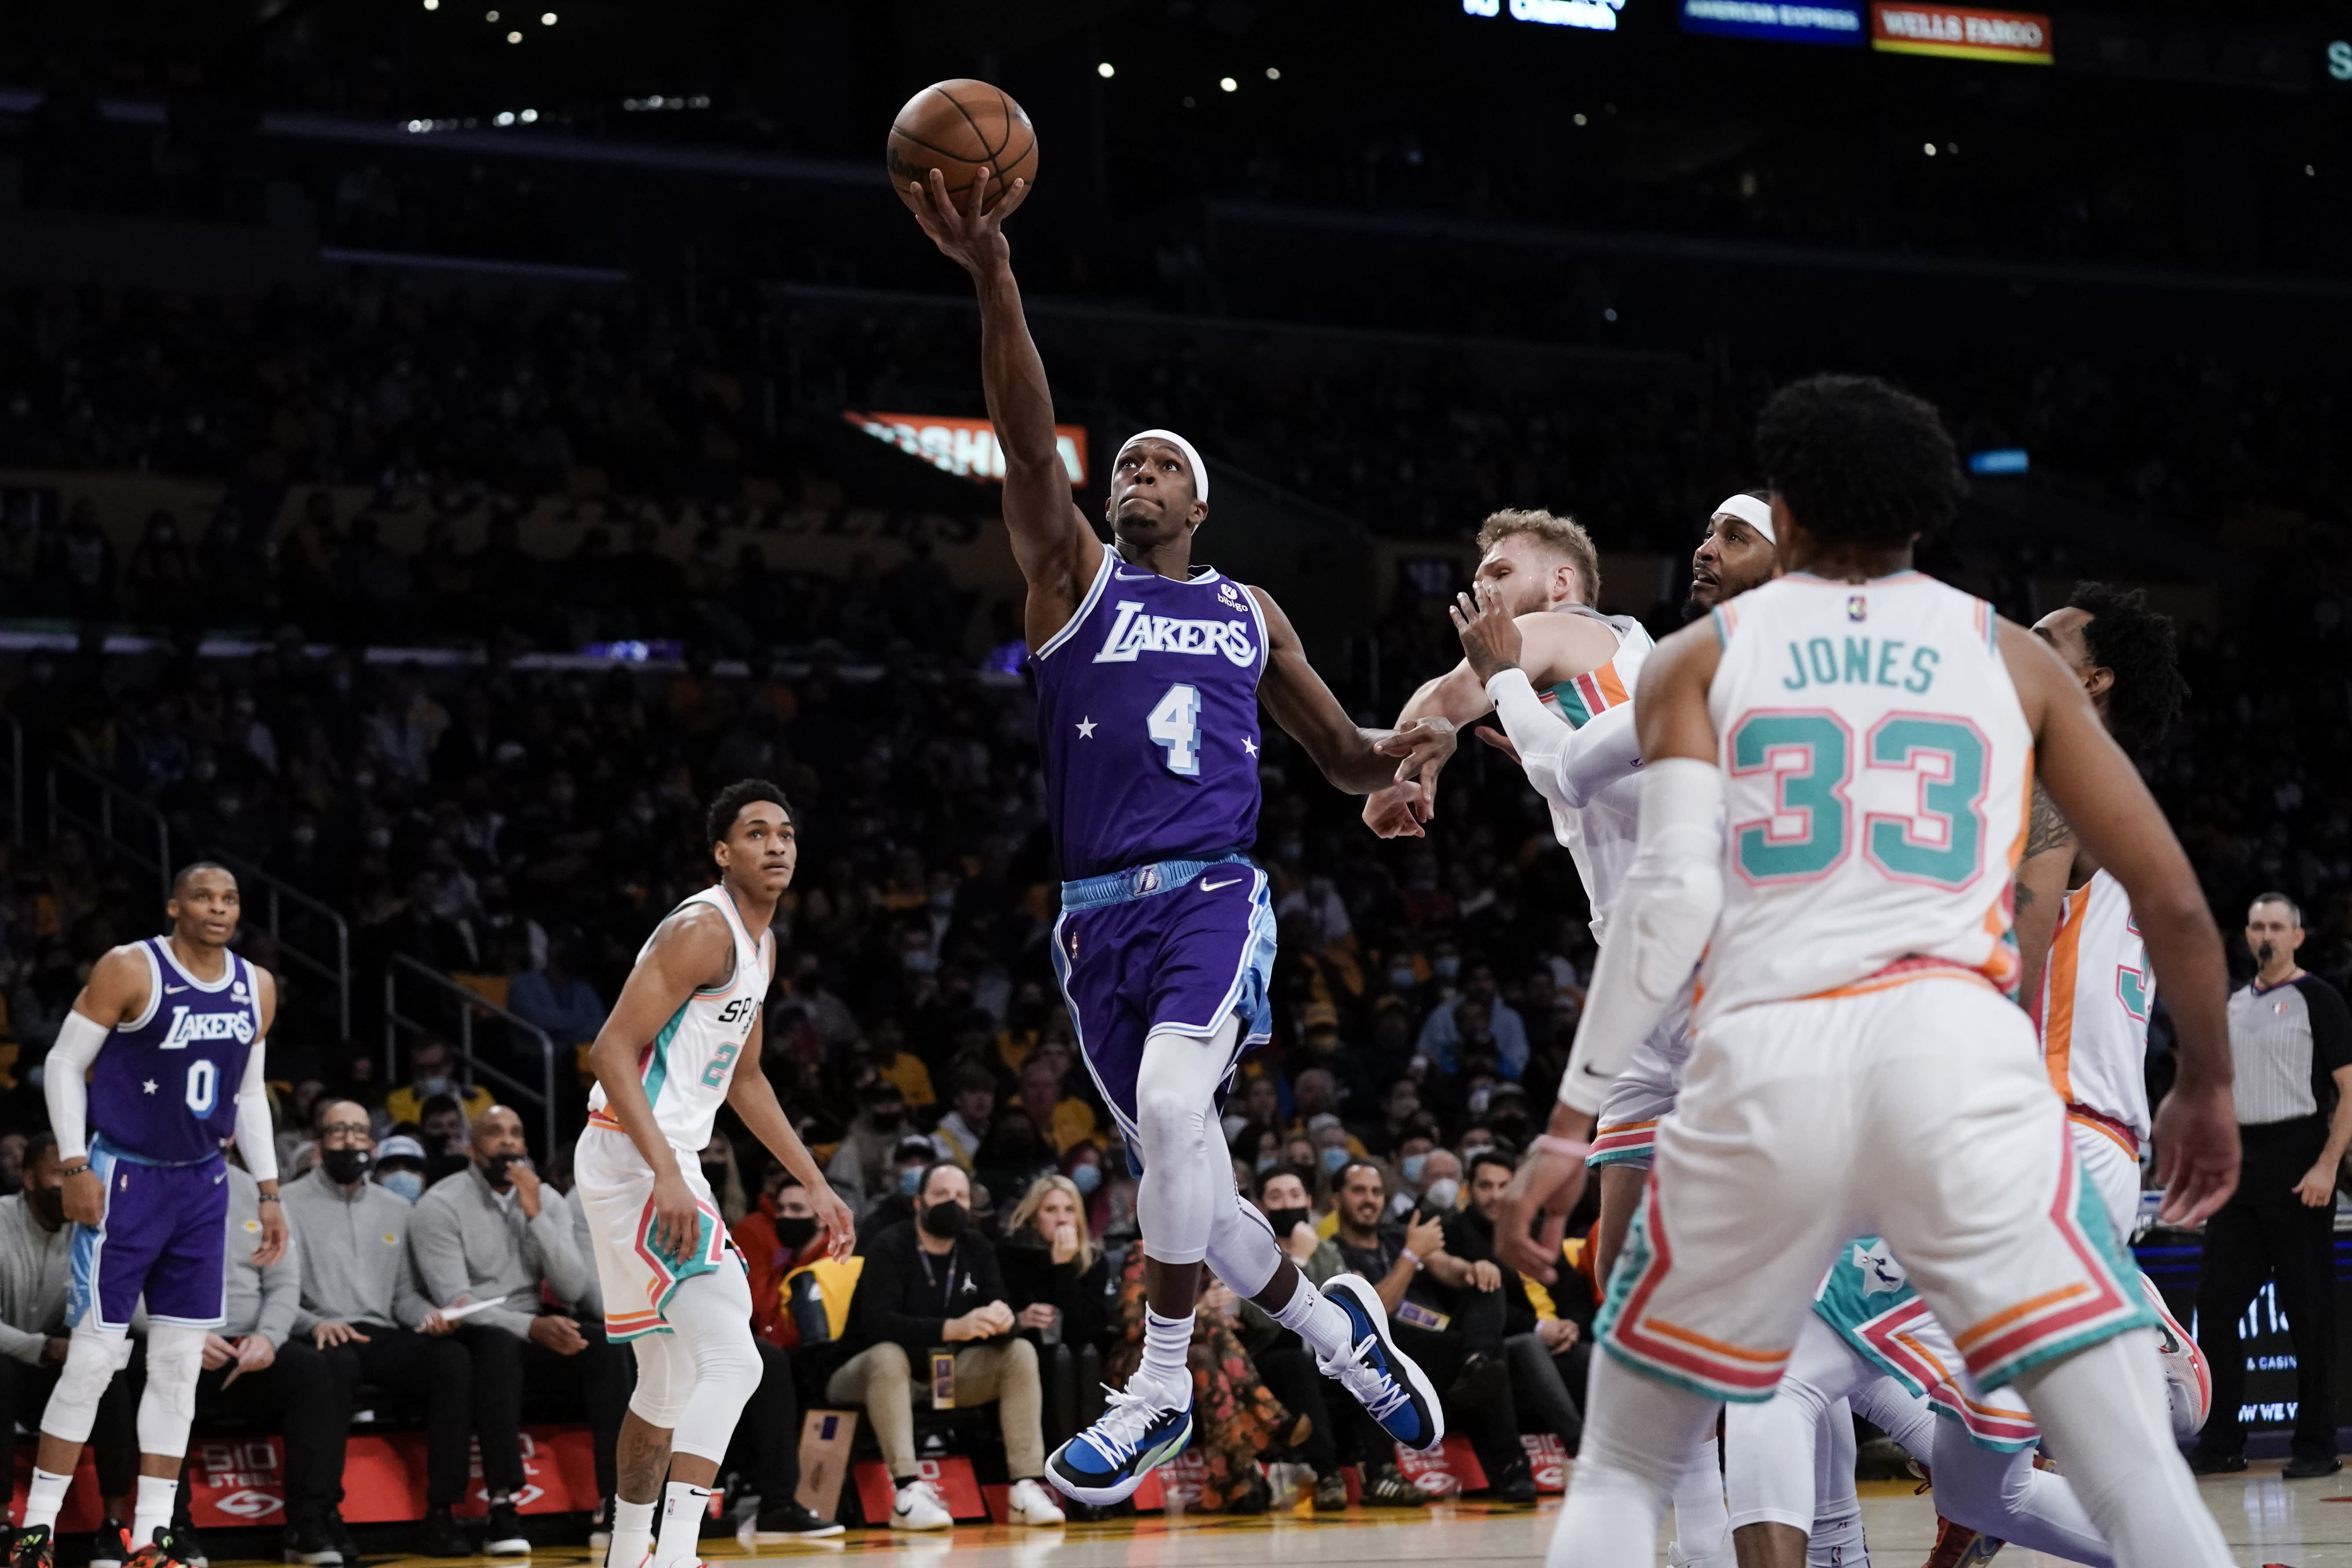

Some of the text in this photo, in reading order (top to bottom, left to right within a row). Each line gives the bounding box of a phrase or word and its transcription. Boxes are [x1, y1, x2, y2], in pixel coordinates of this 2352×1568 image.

[1882, 10, 2043, 48] WELLS FARGO
[1217, 593, 1249, 612] bibigo
[1091, 600, 1257, 668] LAKERS
[1783, 636, 1940, 694] JONES
[1146, 682, 1201, 775] 4
[1728, 708, 1992, 893] 33
[159, 1005, 255, 1049] LAKERS
[186, 1059, 220, 1120] 0
[208, 1473, 282, 1489] STEEL
